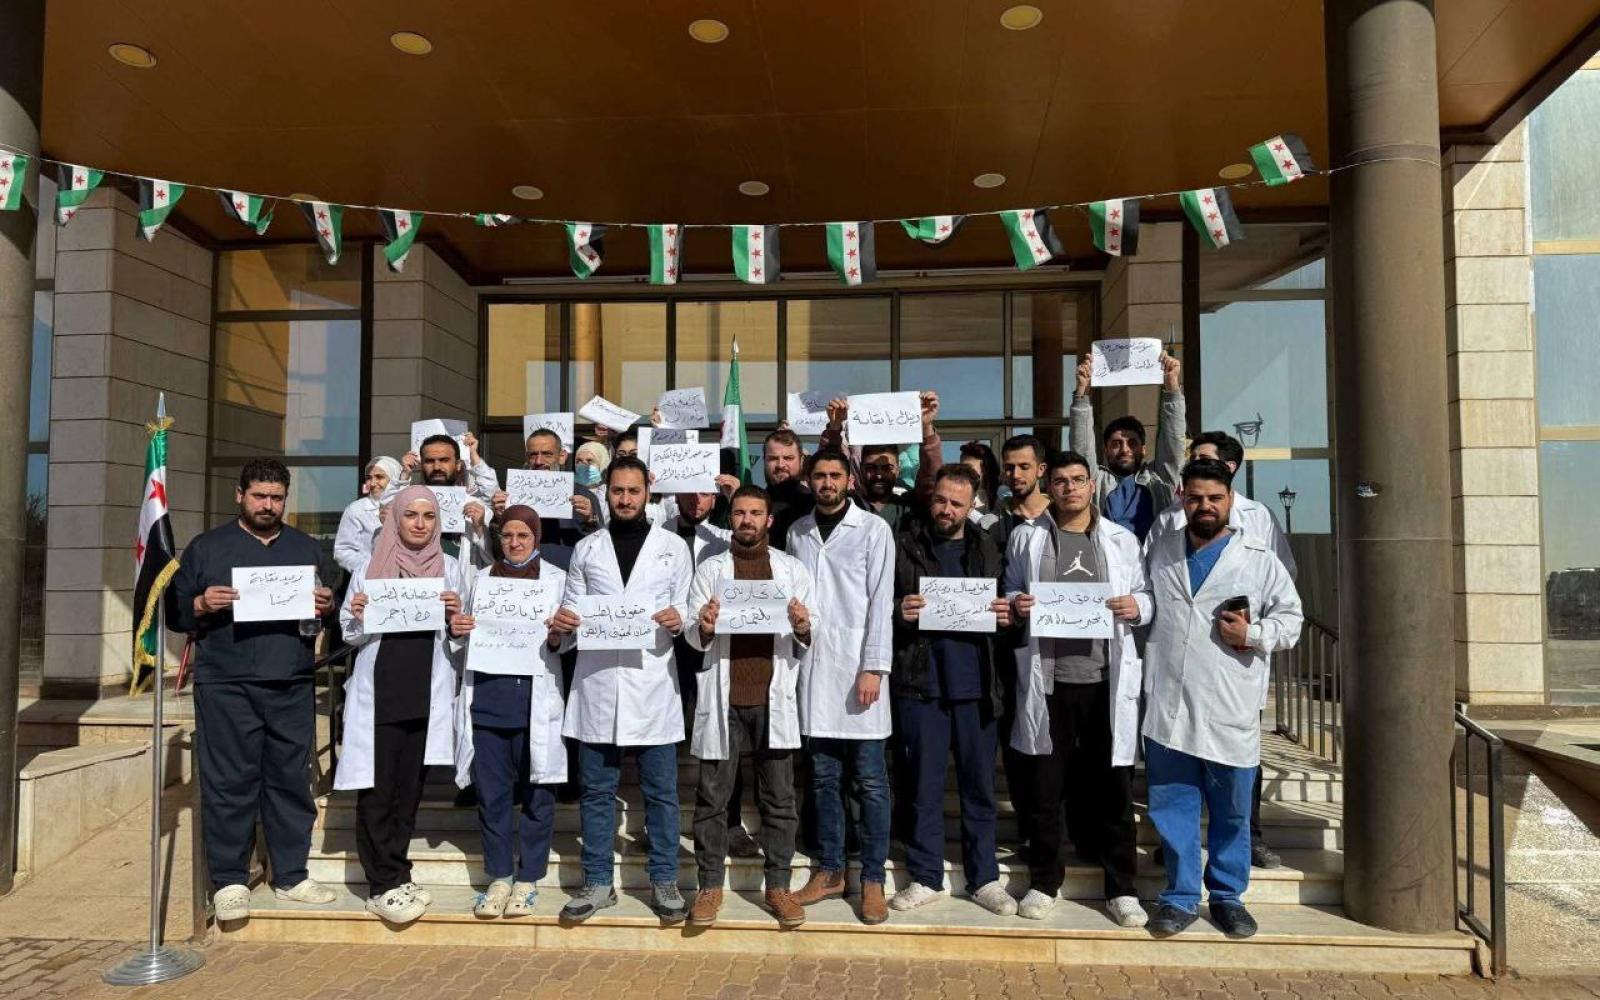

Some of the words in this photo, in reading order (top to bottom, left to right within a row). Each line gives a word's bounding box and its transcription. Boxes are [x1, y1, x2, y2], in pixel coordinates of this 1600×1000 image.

[853, 410, 884, 425] نقابة
[250, 571, 279, 585] نقابة
[400, 585, 438, 600] حصانة
[773, 583, 787, 600] لا
[1068, 593, 1090, 605] حق
[377, 607, 408, 627] أحمر
[614, 604, 647, 620] حقوق
